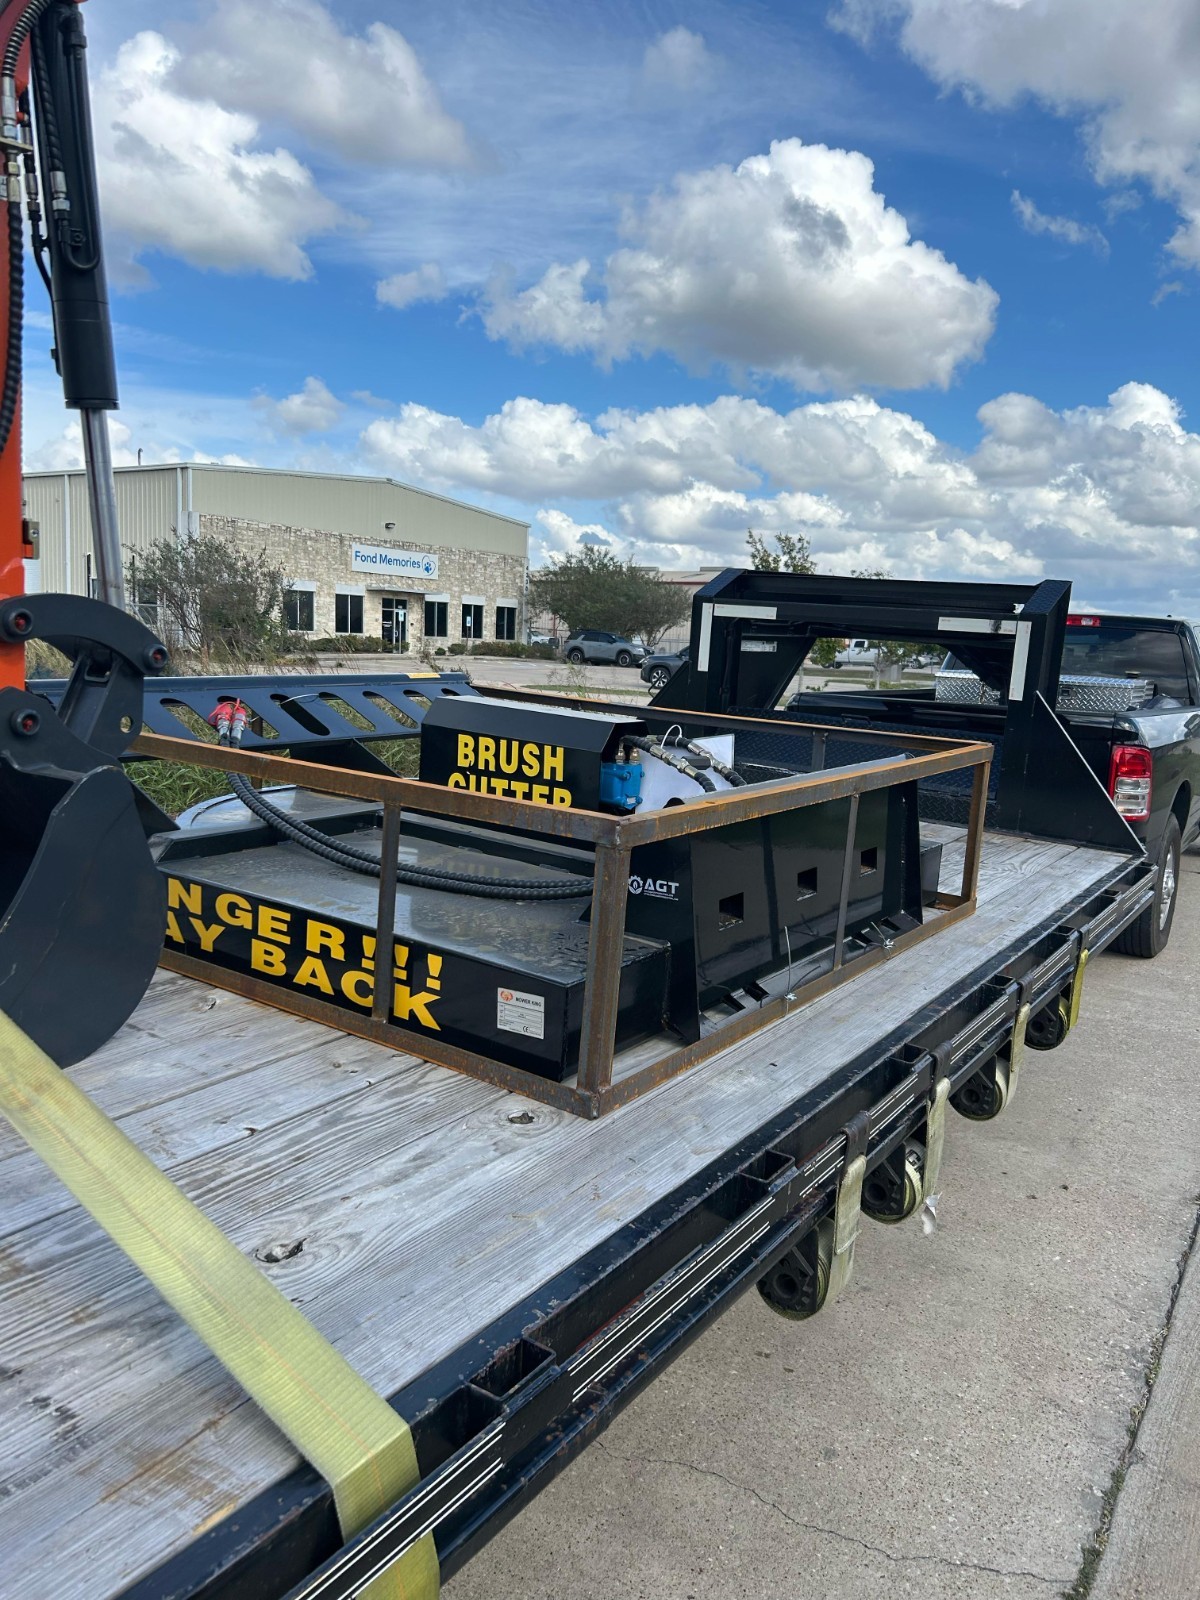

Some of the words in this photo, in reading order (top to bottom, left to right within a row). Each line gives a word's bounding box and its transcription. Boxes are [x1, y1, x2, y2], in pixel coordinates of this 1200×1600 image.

[355, 551, 377, 564] Fond
[380, 553, 421, 569] Memories
[457, 733, 564, 782] BRUSH
[644, 878, 680, 895] AGT
[168, 878, 442, 991] NGER!!!
[165, 911, 226, 953] AY
[251, 938, 442, 1031] BACK
